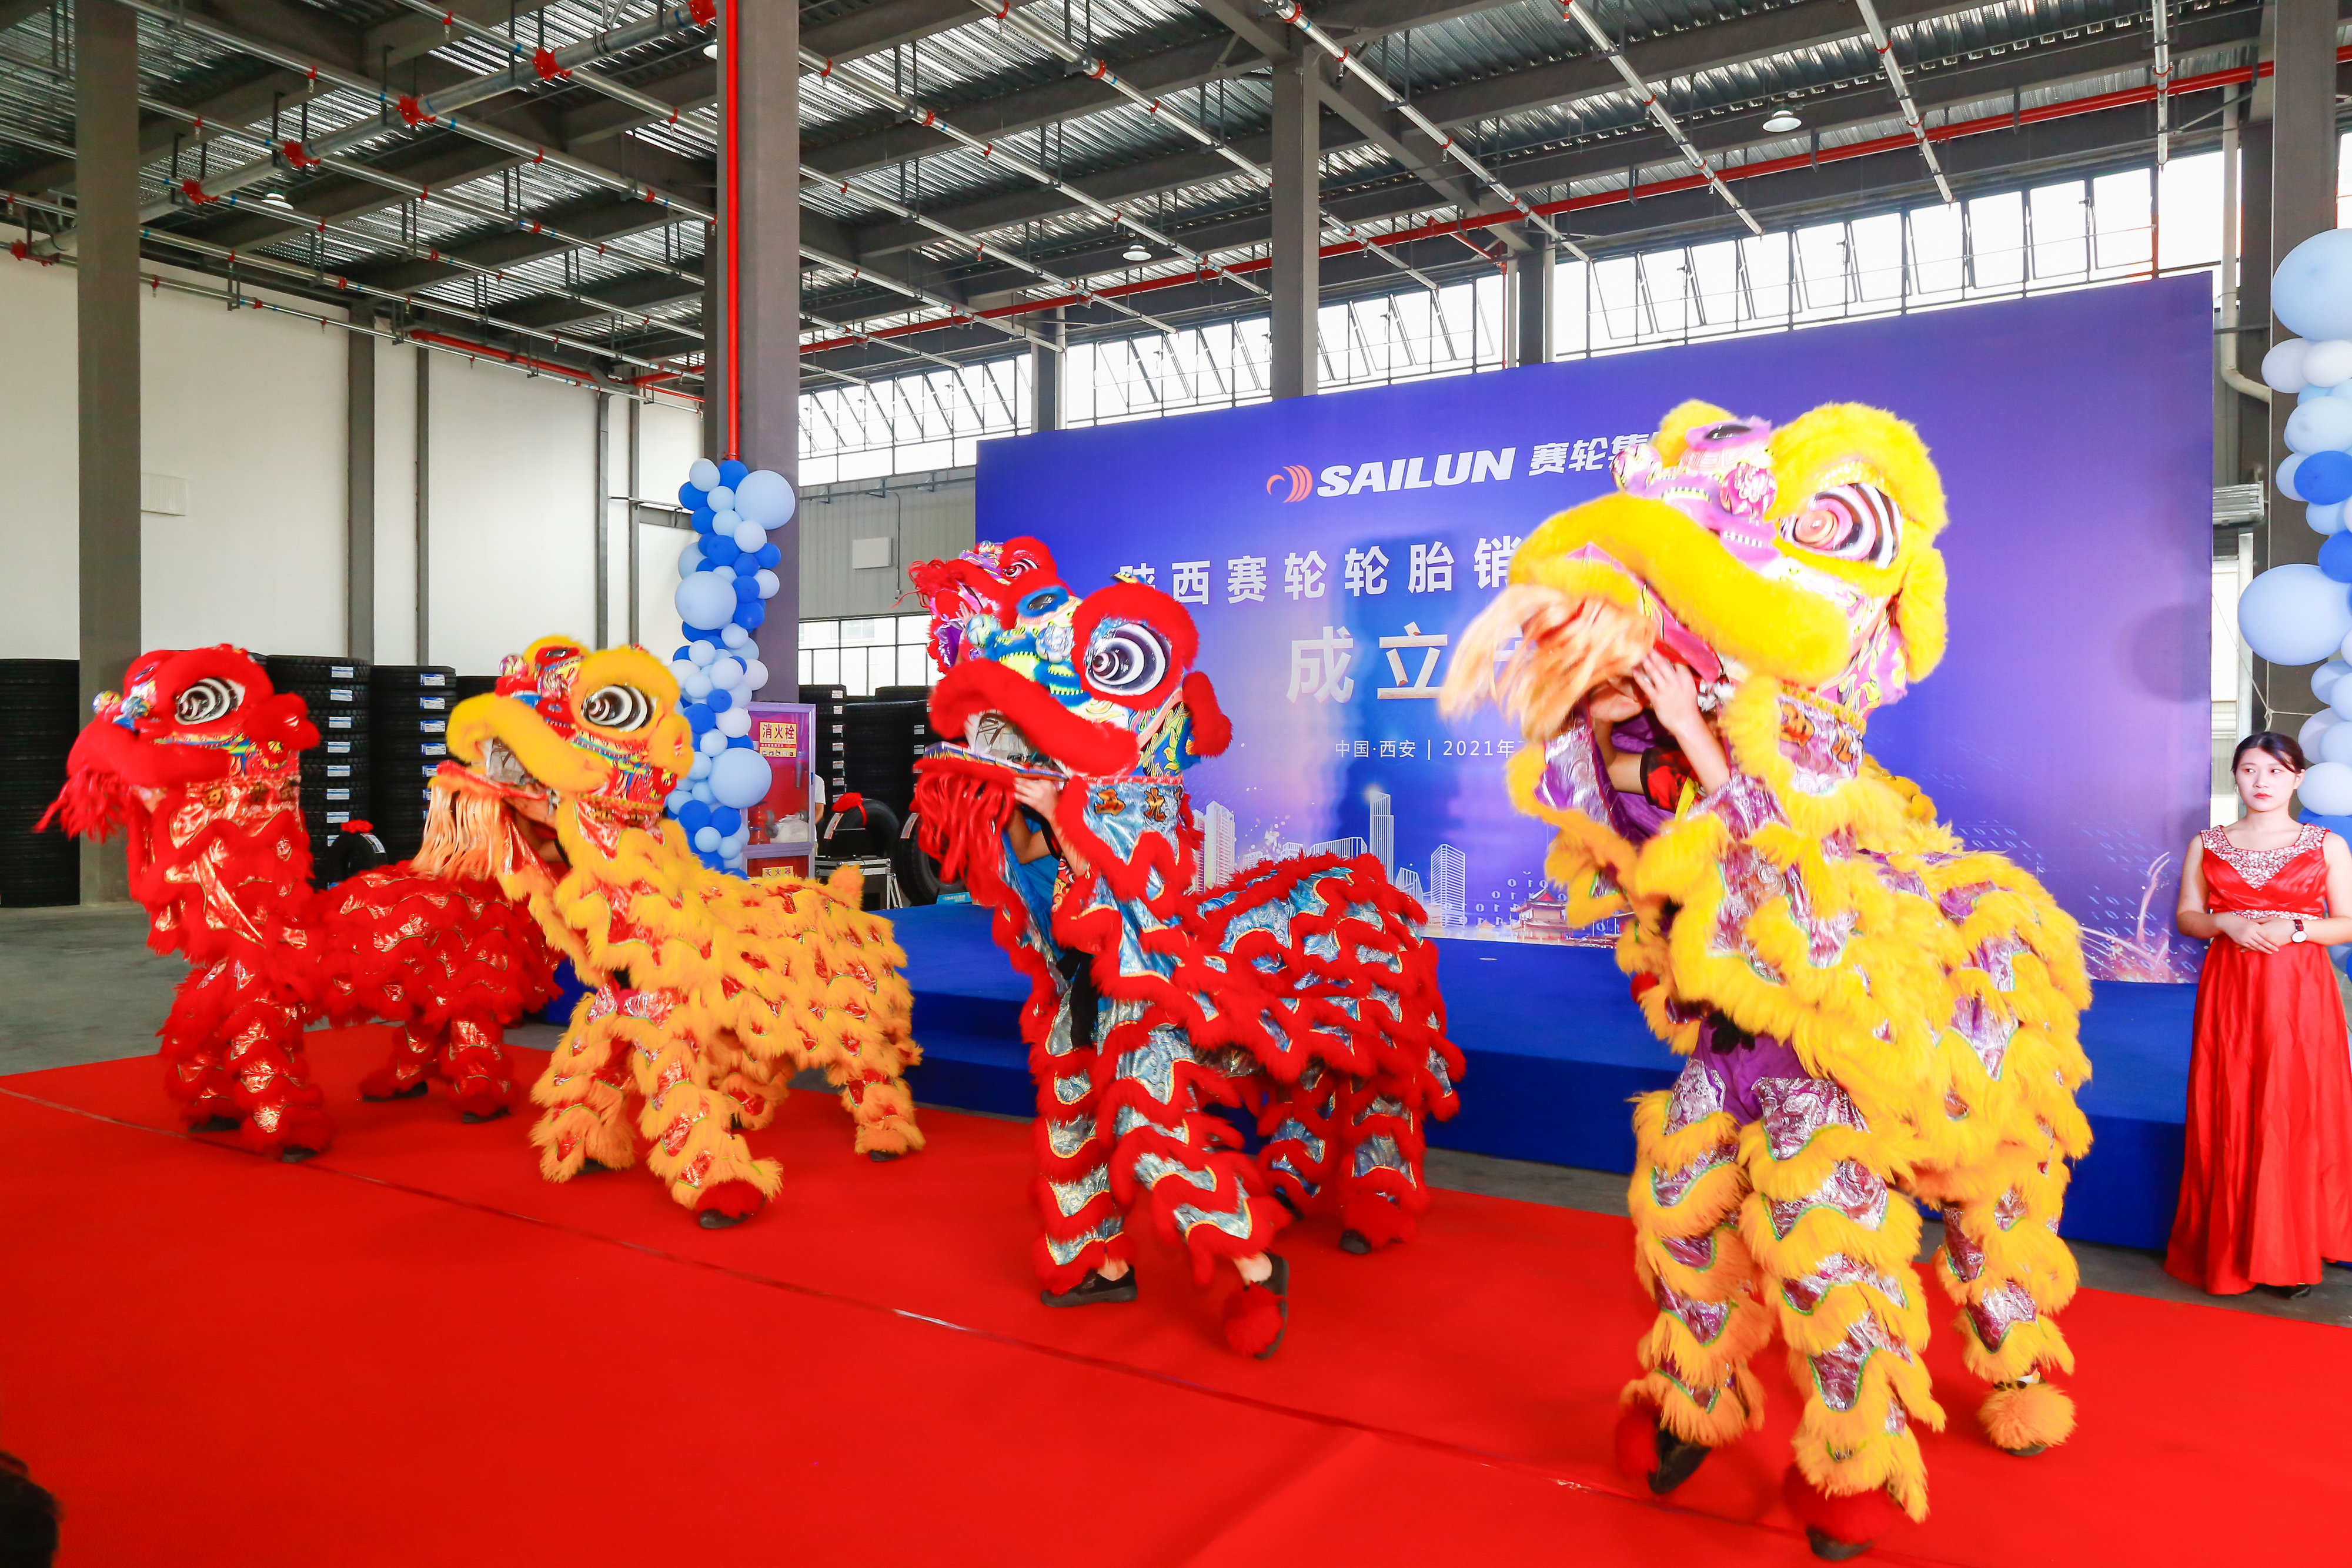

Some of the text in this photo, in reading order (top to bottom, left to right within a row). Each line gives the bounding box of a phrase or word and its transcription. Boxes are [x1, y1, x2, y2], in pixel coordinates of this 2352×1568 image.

[1528, 431, 1655, 476] 赛轮集
[1317, 447, 1516, 497] SAILUN
[763, 724, 795, 740] 消火栓
[1335, 739, 1416, 758] 中国·西安
[765, 867, 791, 876] 灭火器
